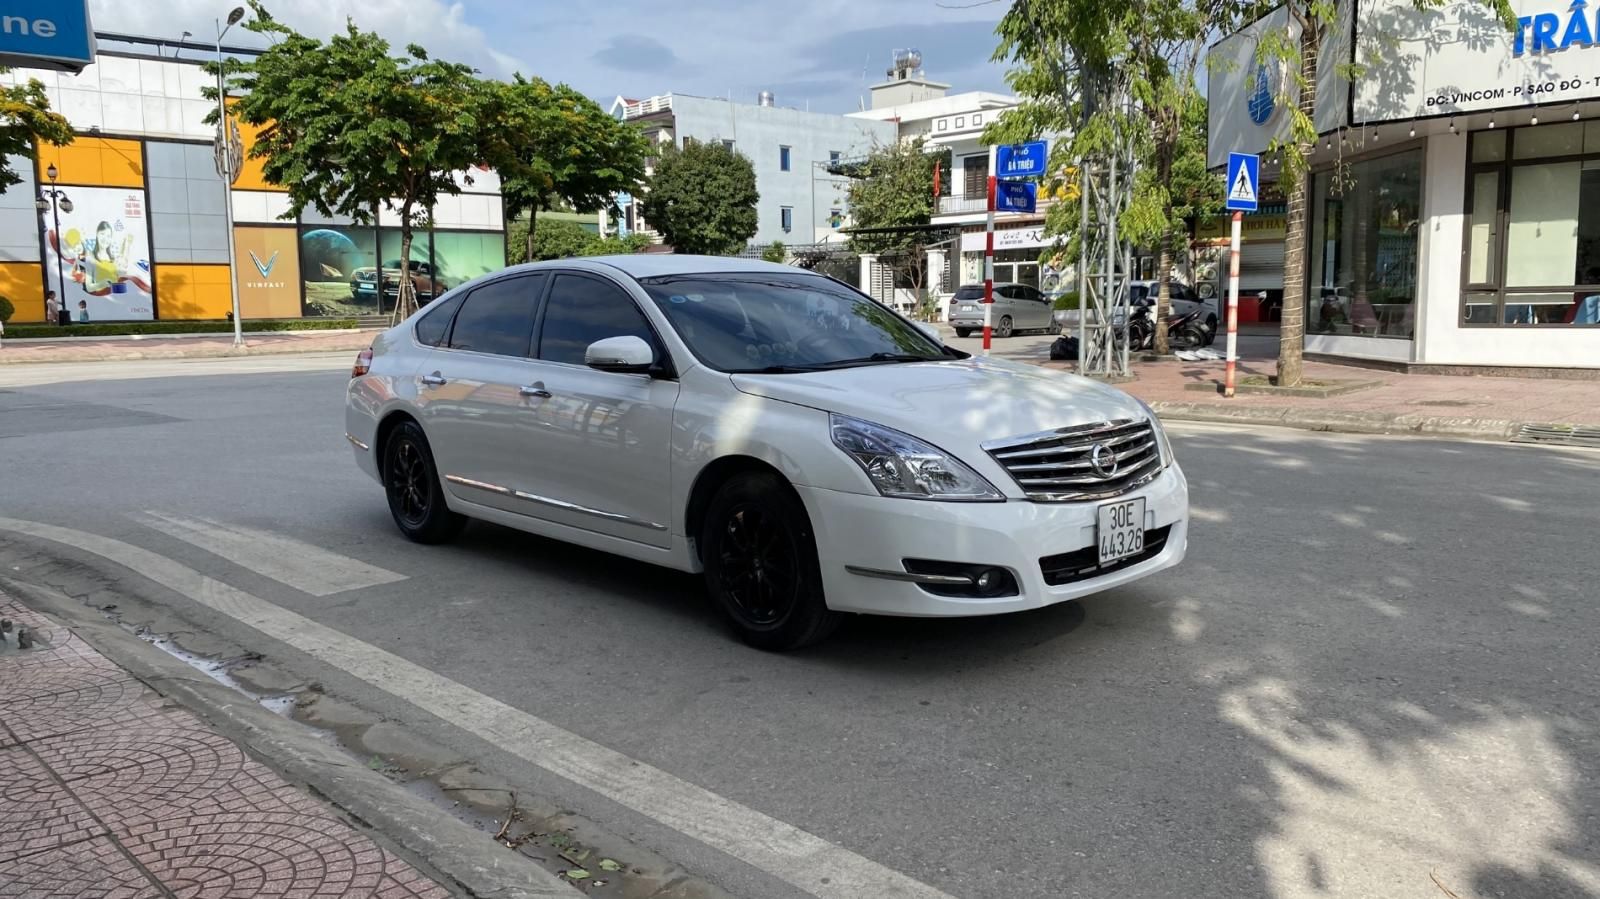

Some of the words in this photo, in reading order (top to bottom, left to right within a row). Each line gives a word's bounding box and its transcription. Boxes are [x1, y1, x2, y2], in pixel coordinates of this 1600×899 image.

[3, 15, 57, 38] ne
[1427, 94, 1449, 106] ĐC:
[1452, 89, 1504, 104] VINCOM
[1513, 86, 1524, 97] P.
[1528, 82, 1555, 95] SAO
[1560, 75, 1582, 91] ĐỎ
[1109, 502, 1135, 530] 30E
[1101, 527, 1143, 559] 443.26
